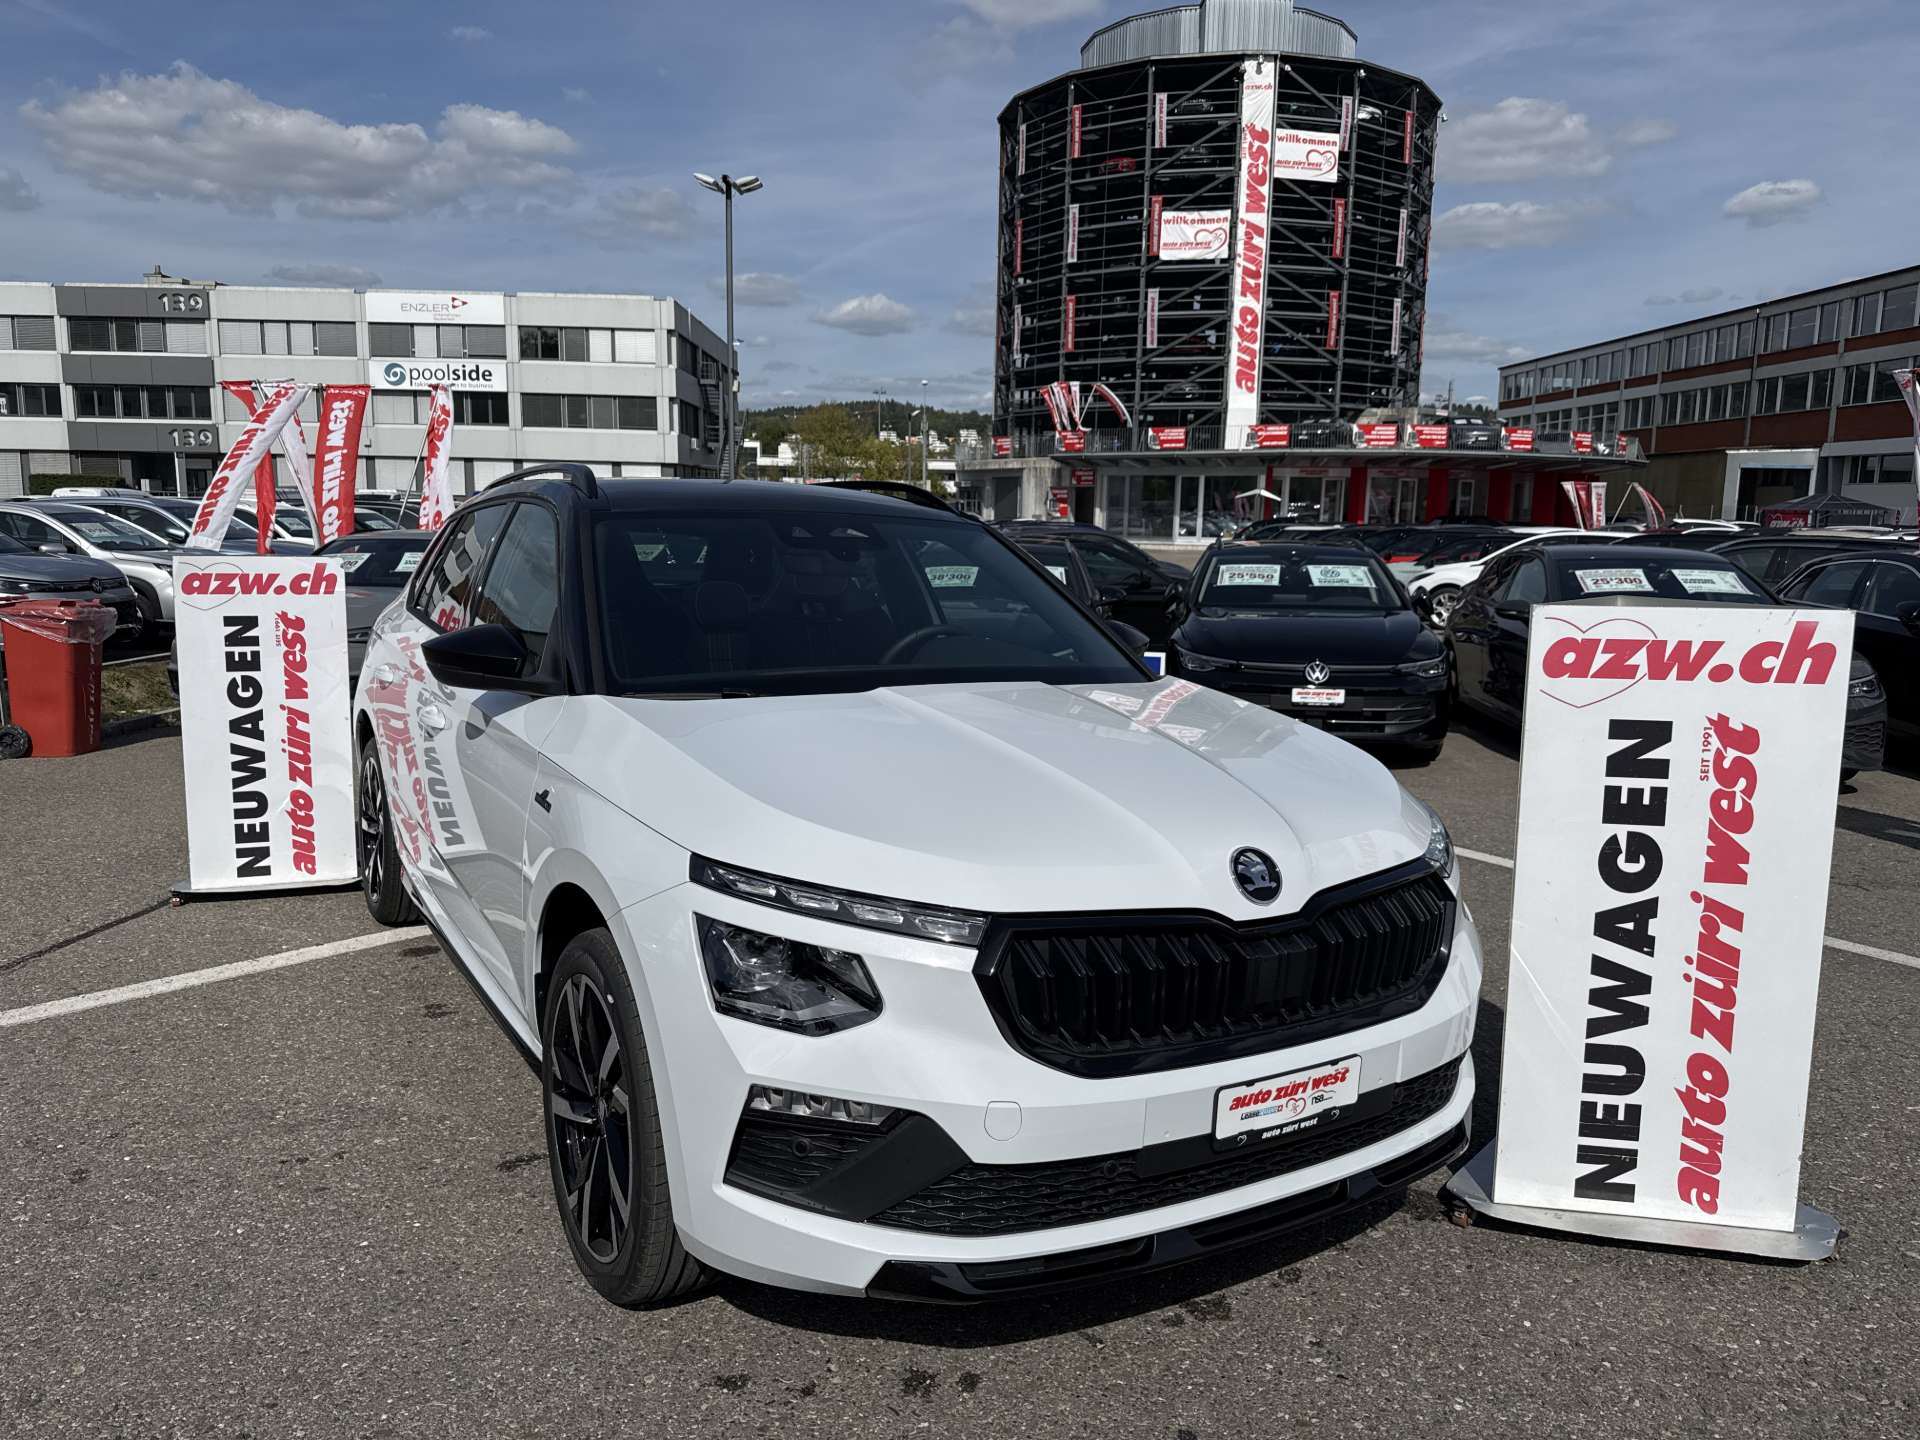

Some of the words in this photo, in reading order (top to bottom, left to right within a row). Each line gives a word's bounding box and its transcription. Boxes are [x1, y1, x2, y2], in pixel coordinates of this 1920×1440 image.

[1245, 123, 1270, 214] west
[1277, 134, 1337, 147] willkommen
[1163, 216, 1228, 225] willkommen
[1235, 218, 1265, 305] züri
[158, 293, 203, 312] 139
[401, 303, 449, 312] ENZLER
[410, 364, 492, 386] poolside
[1234, 306, 1260, 394] auto
[169, 428, 213, 448] 139
[181, 562, 337, 597] azw.ch
[274, 610, 309, 700] west
[1542, 621, 1838, 685] azw.ch
[223, 615, 271, 879] NEUWAGEN
[279, 703, 314, 788] züri
[1699, 755, 1710, 782] SEIT
[1702, 725, 1713, 754] 1991
[1704, 712, 1762, 886] west
[284, 789, 317, 876] auto
[1574, 718, 1673, 1204] NEUWAGEN
[1681, 890, 1746, 1055] züri
[1229, 1089, 1272, 1111] auto
[1271, 1077, 1311, 1101] züri
[1312, 1066, 1350, 1091] west
[1262, 1128, 1281, 1139] auto
[1300, 1117, 1319, 1129] west
[1674, 1052, 1731, 1216] auto
